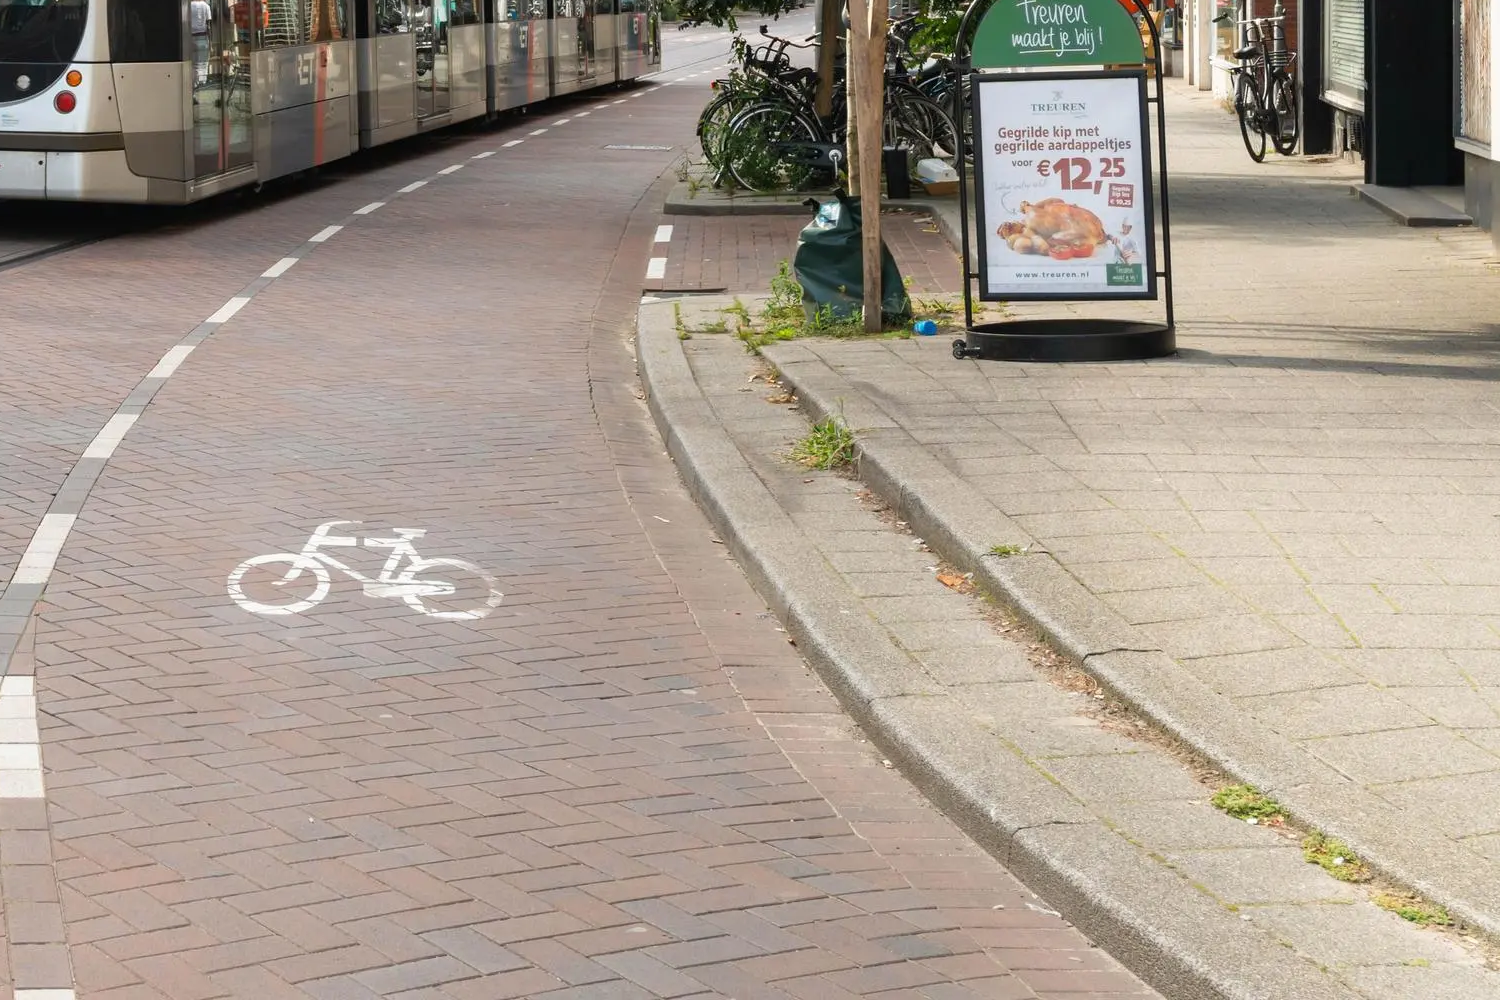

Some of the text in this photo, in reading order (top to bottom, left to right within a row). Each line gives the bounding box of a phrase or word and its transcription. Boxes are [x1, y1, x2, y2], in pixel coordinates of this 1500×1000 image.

[1011, 27, 1055, 49] maakt
[1056, 28, 1071, 57] je
[1074, 27, 1095, 55] blij
[1030, 102, 1087, 112] TREUREN
[998, 126, 1100, 141] Gegrilde kip met
[994, 137, 1132, 155] gegrilde aardappeltjes
[1011, 159, 1033, 167] voor
[1015, 270, 1090, 279] www.treuren.nl
